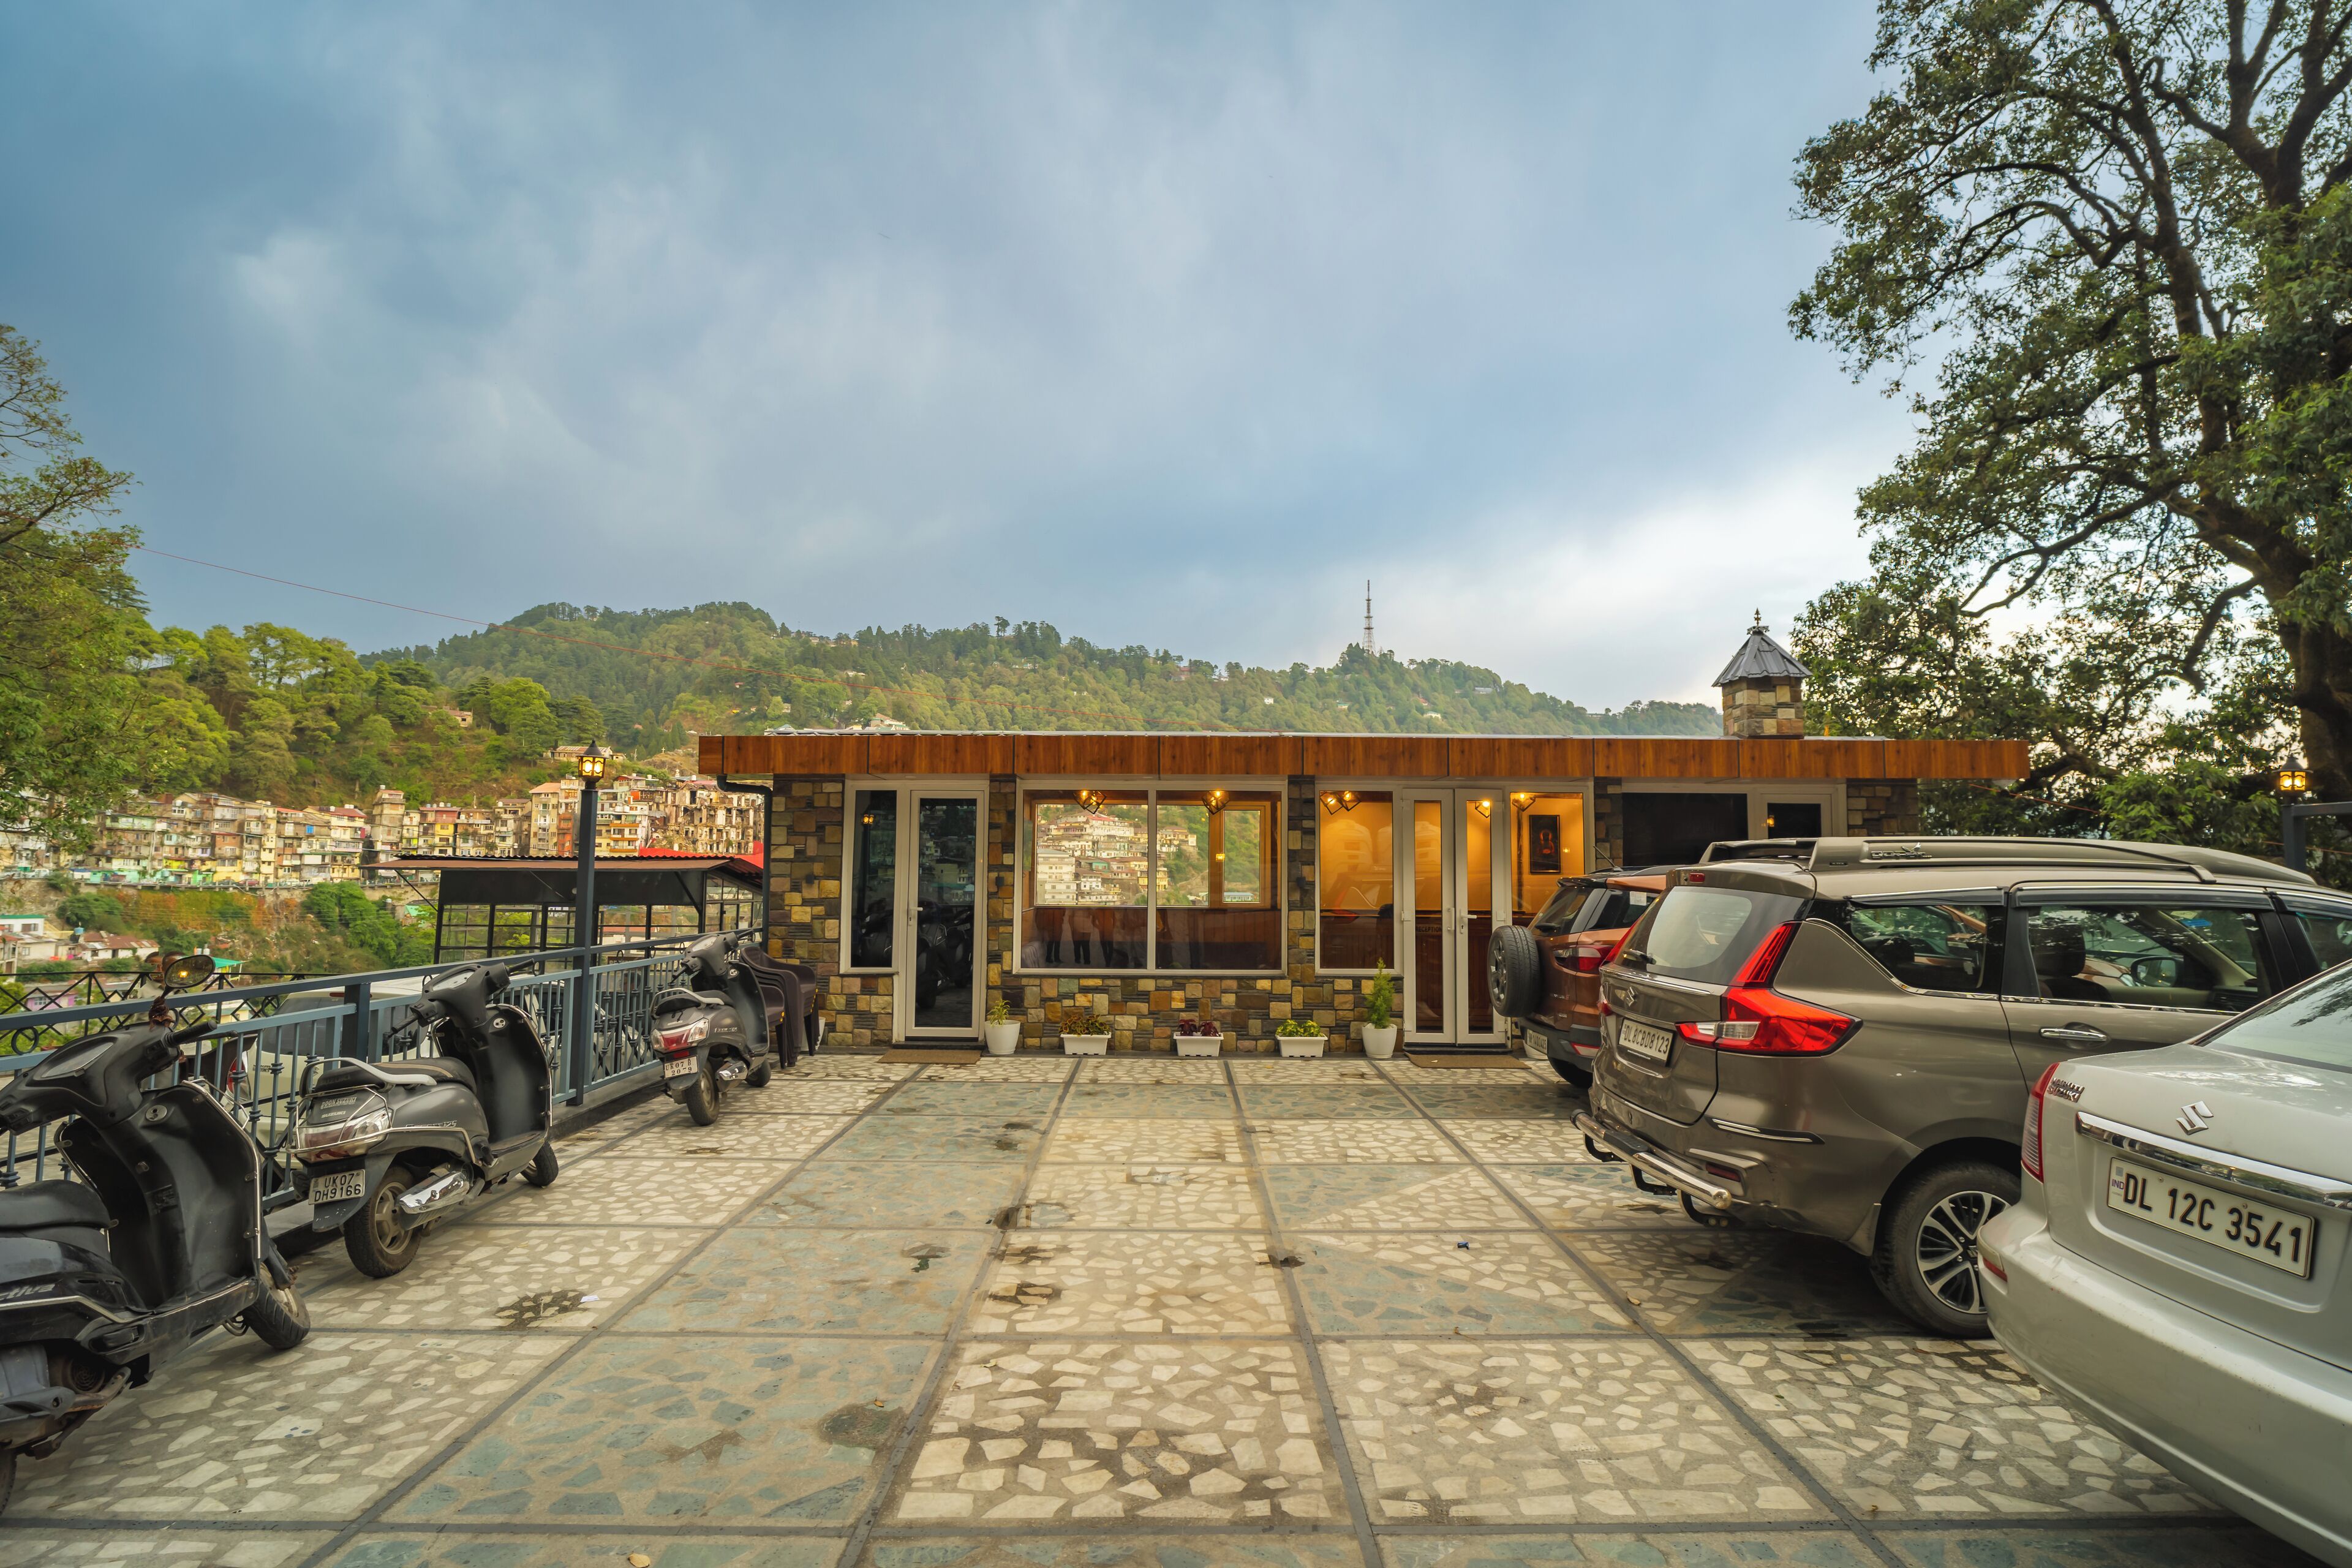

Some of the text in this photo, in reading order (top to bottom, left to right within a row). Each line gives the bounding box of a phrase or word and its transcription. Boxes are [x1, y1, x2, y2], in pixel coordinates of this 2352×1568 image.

[2047, 1085, 2081, 1102] SUZUKI
[2052, 1078, 2085, 1094] MARUTI
[314, 1183, 361, 1202] DH9166
[2111, 1178, 2125, 1190] IND
[2124, 1173, 2301, 1262] DL 12C 3541
